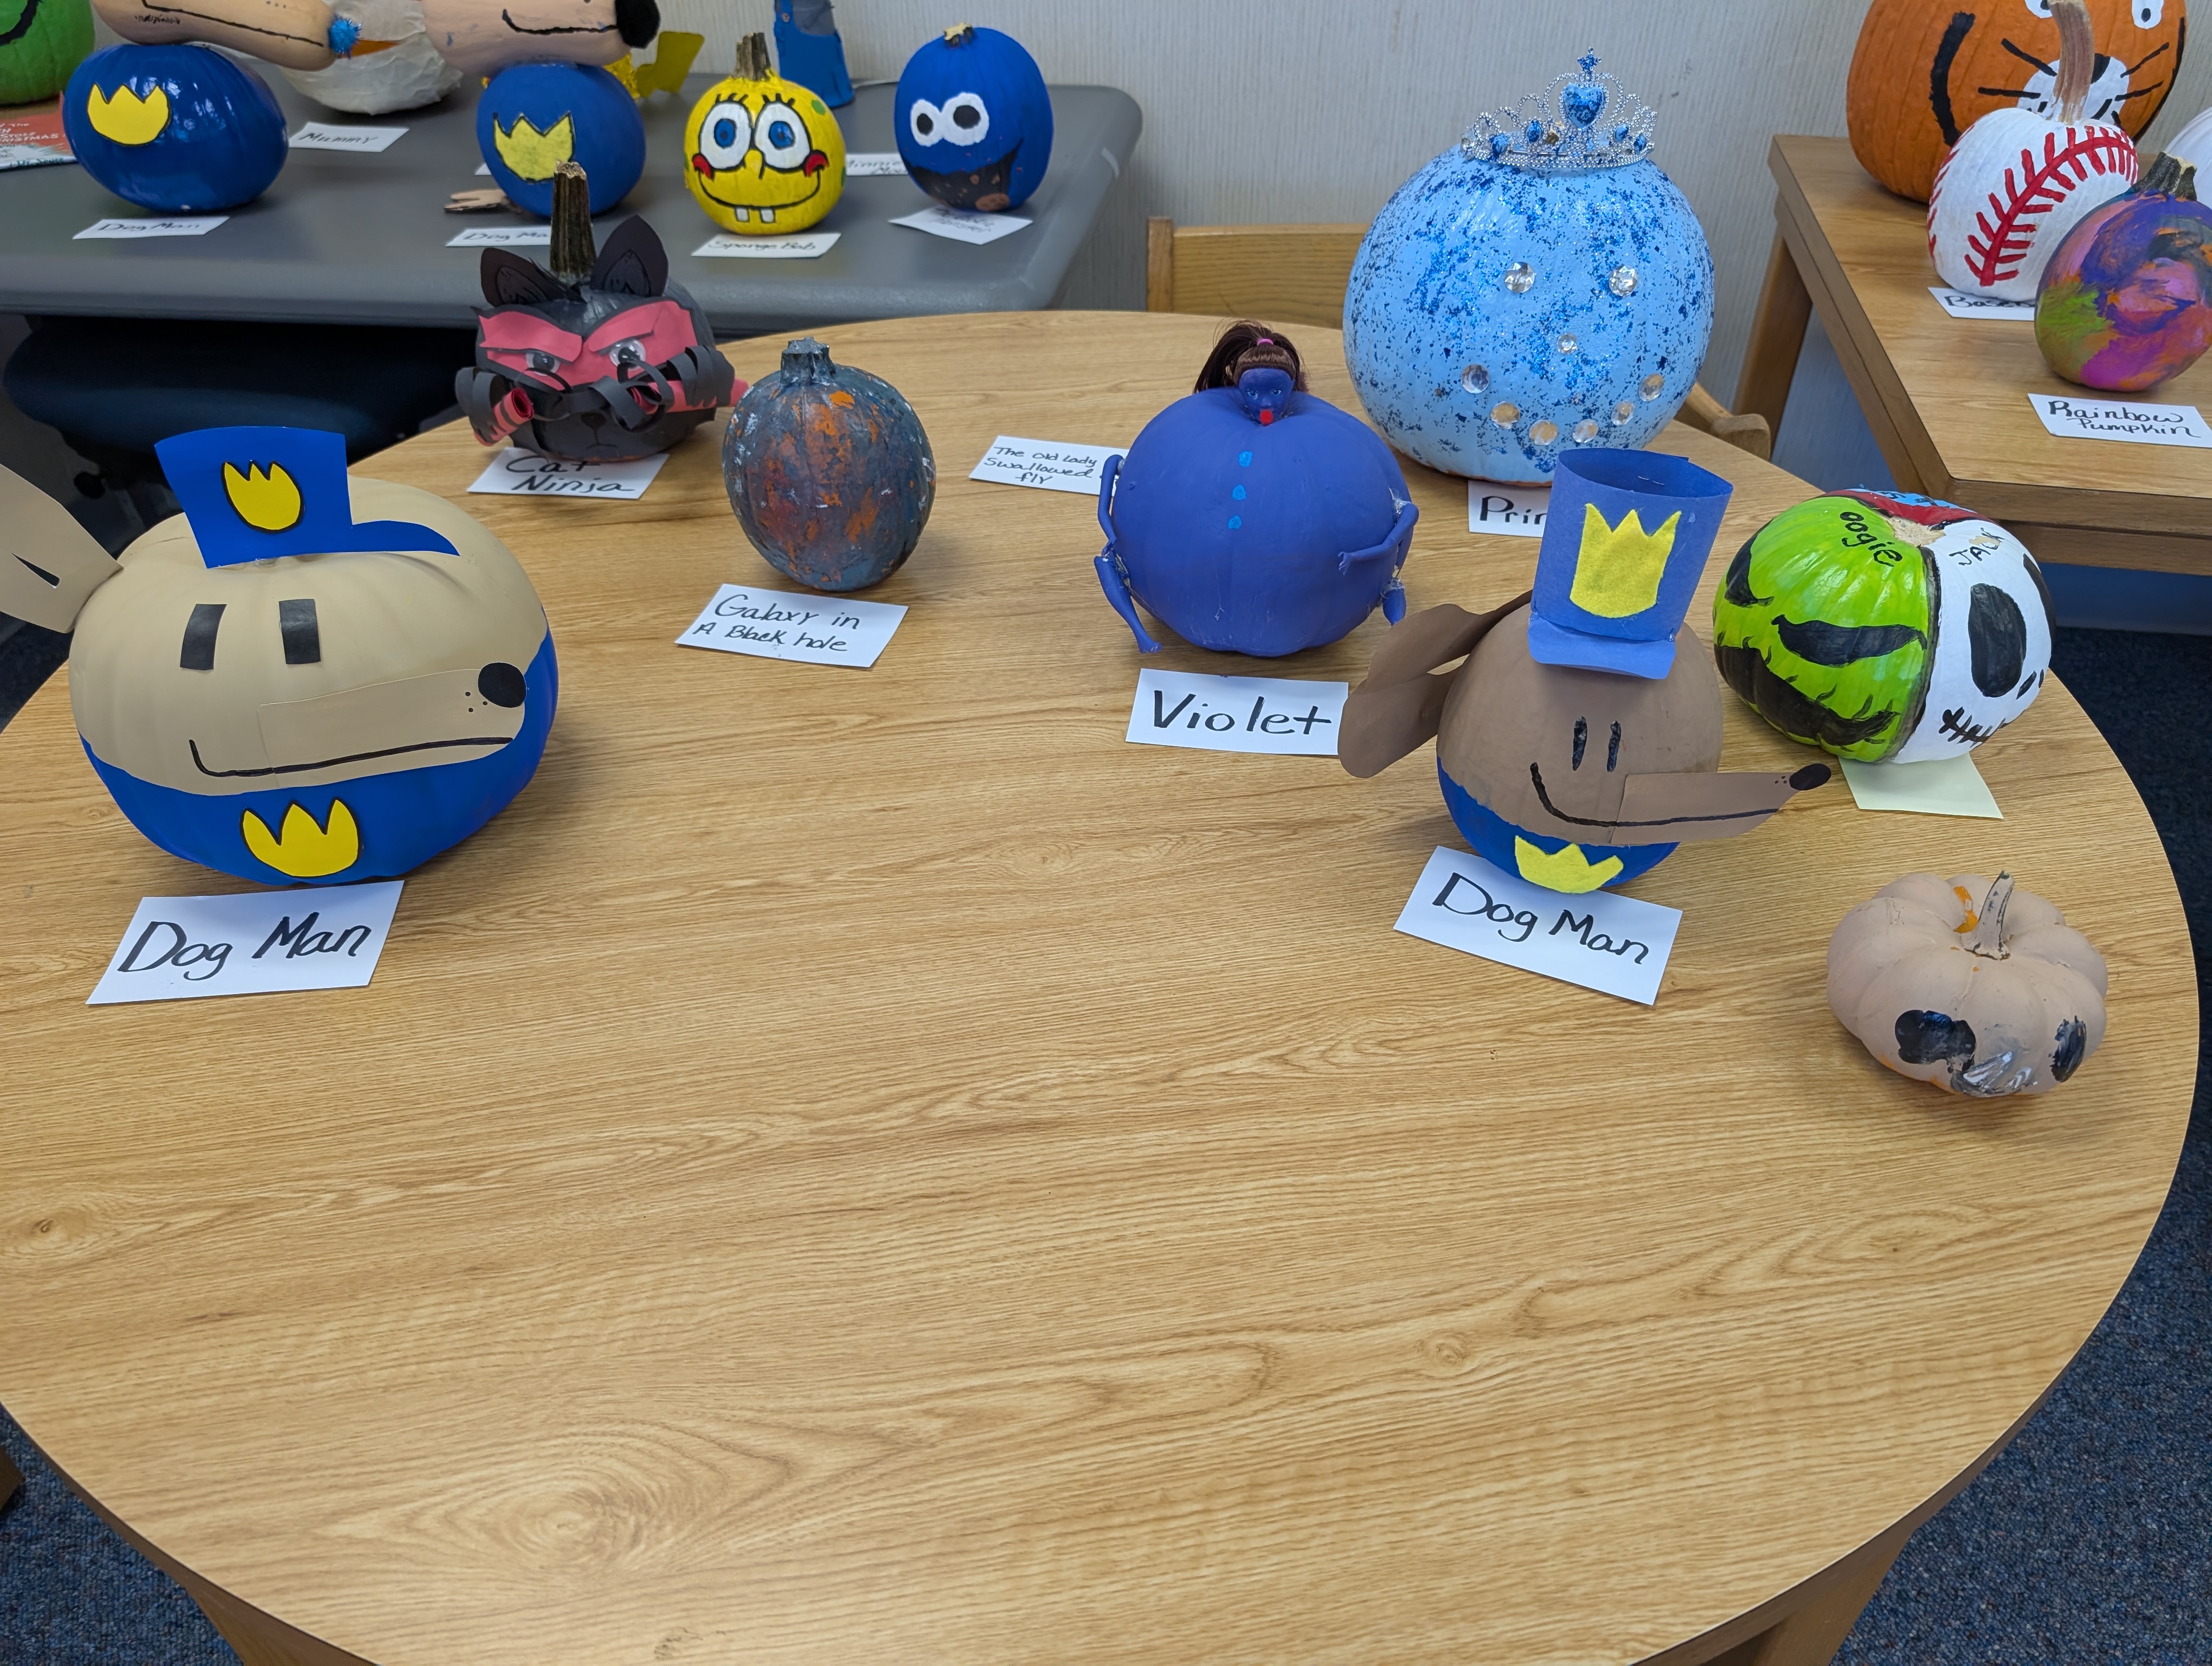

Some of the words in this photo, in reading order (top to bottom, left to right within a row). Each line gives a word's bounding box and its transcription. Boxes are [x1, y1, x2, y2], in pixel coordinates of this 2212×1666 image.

[98, 223, 146, 232] Dog
[463, 234, 511, 242] Dog
[2048, 400, 2184, 423] Rainbow
[2067, 418, 2202, 438] Pumpkin
[993, 446, 1025, 457] The
[506, 455, 600, 473] Cat
[511, 475, 635, 493] Ninja
[715, 594, 820, 626] Galaxy
[831, 612, 861, 630] in
[692, 621, 717, 635] A
[724, 625, 788, 644] Black
[793, 632, 848, 652] hole
[1154, 690, 1332, 735] Violet
[1431, 872, 1539, 943] Dog
[1548, 909, 1649, 965] Man
[117, 921, 234, 981] Dog
[251, 911, 372, 959] Man
